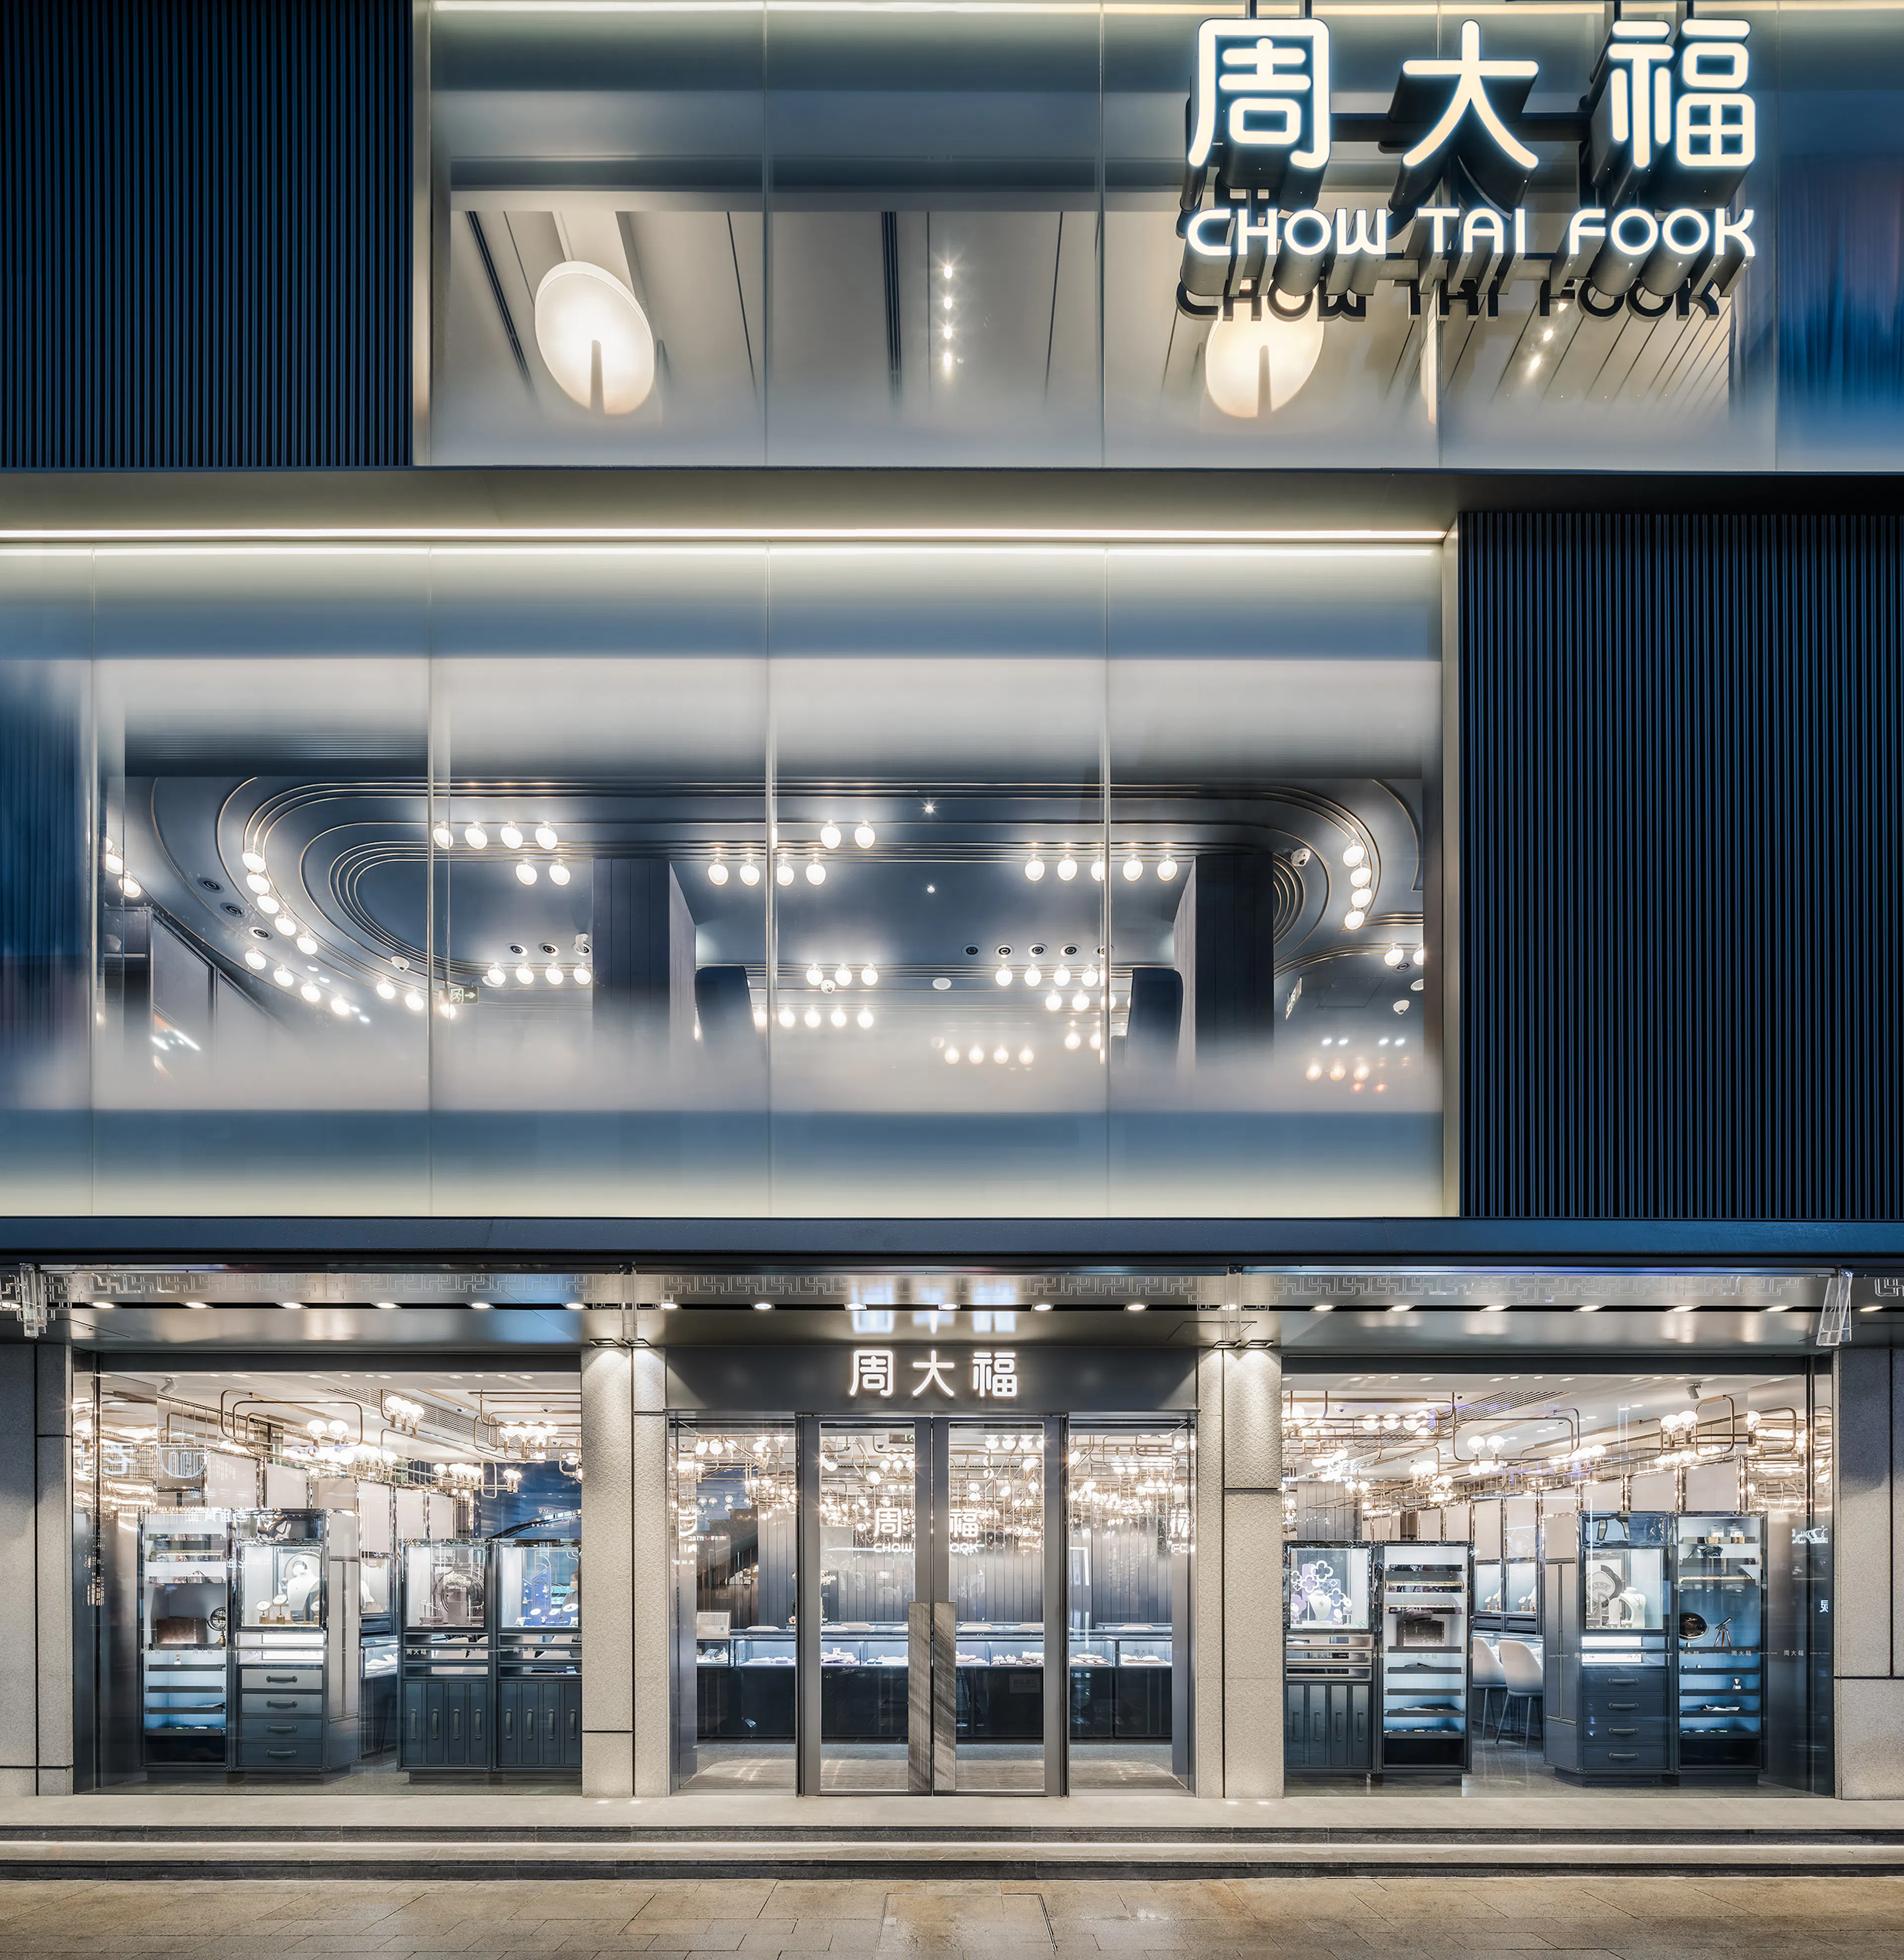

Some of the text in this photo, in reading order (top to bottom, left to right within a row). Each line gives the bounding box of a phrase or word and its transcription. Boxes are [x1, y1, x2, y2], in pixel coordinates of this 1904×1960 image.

[1188, 18, 1755, 168] 周大福
[1187, 207, 1756, 257] CHOW TAI FOOK
[848, 1349, 1018, 1397] 周大福
[873, 1542, 911, 1553] CHOW
